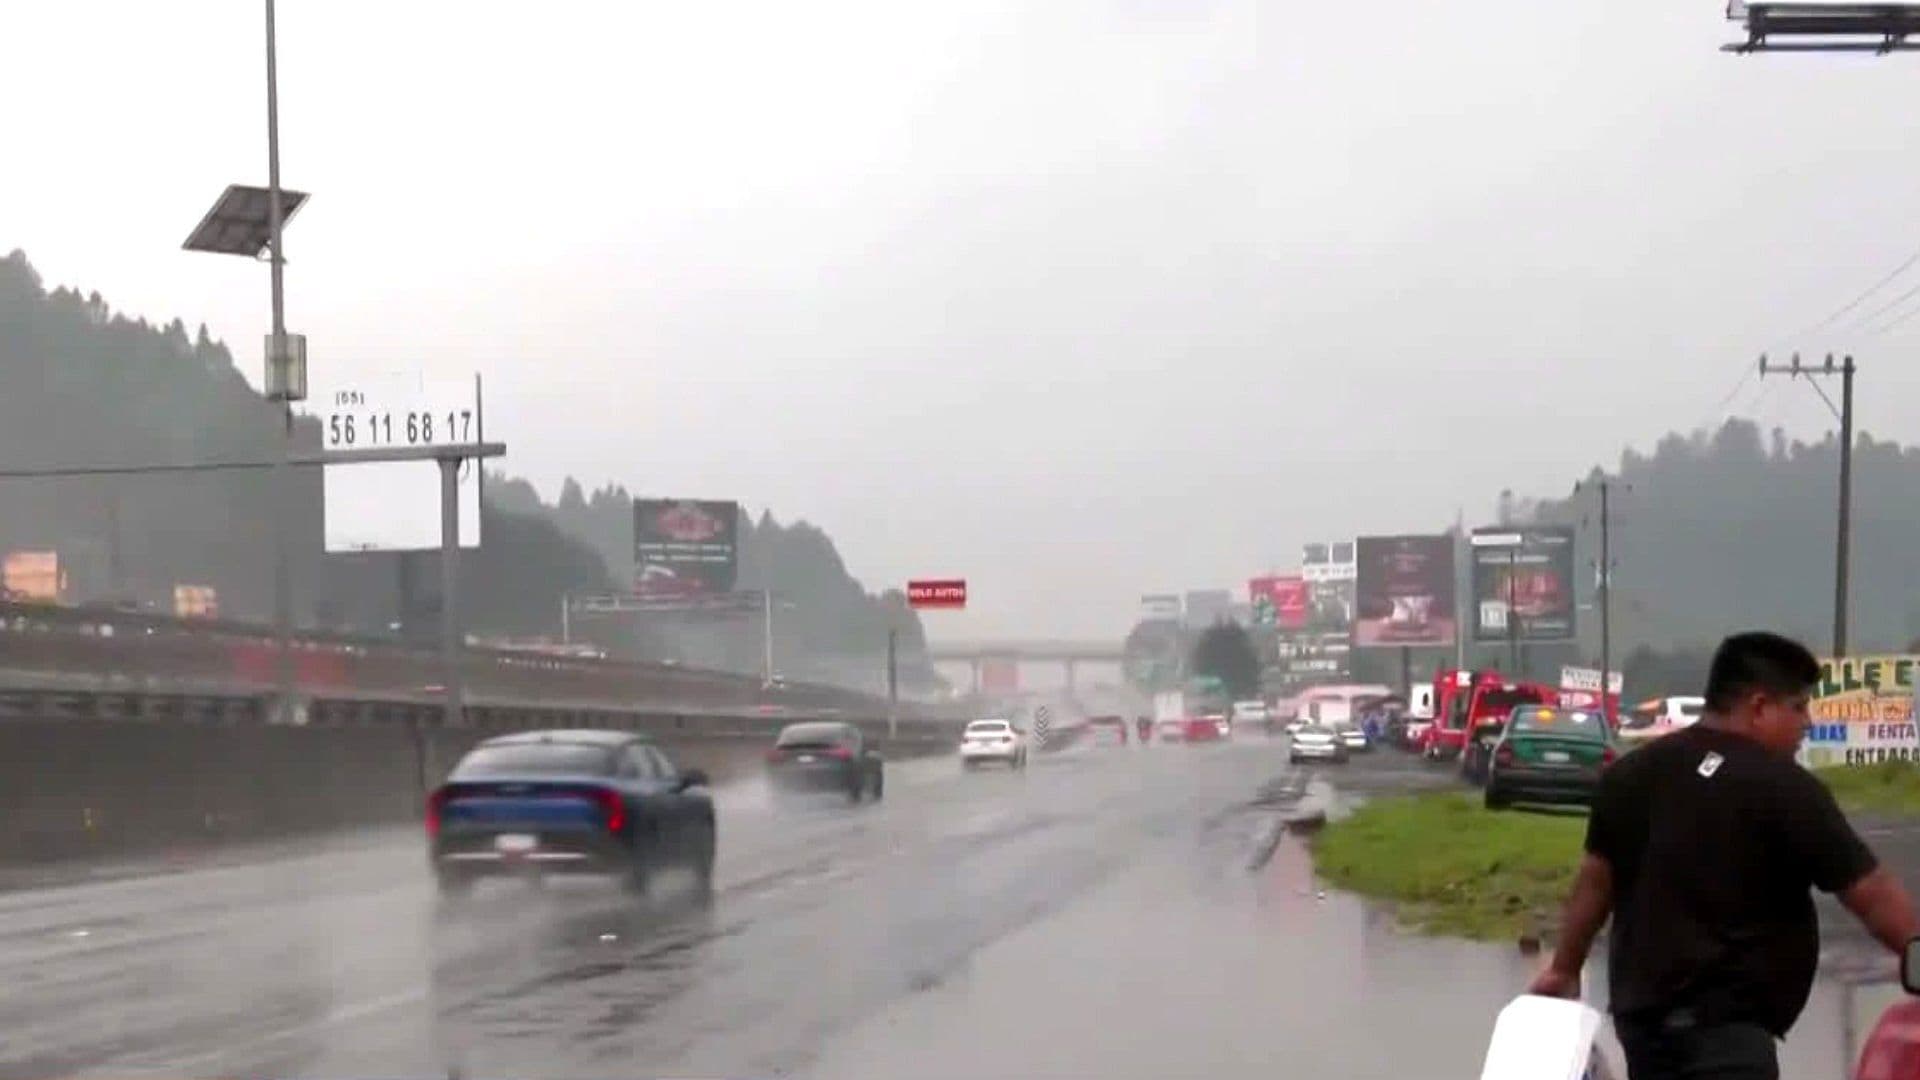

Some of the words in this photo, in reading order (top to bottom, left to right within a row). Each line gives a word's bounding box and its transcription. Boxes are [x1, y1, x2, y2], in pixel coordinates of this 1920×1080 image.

[331, 414, 355, 445] 56
[370, 413, 391, 443] 11
[407, 412, 433, 443] 68
[448, 411, 471, 441] 17
[1868, 723, 1916, 739] RENTA
